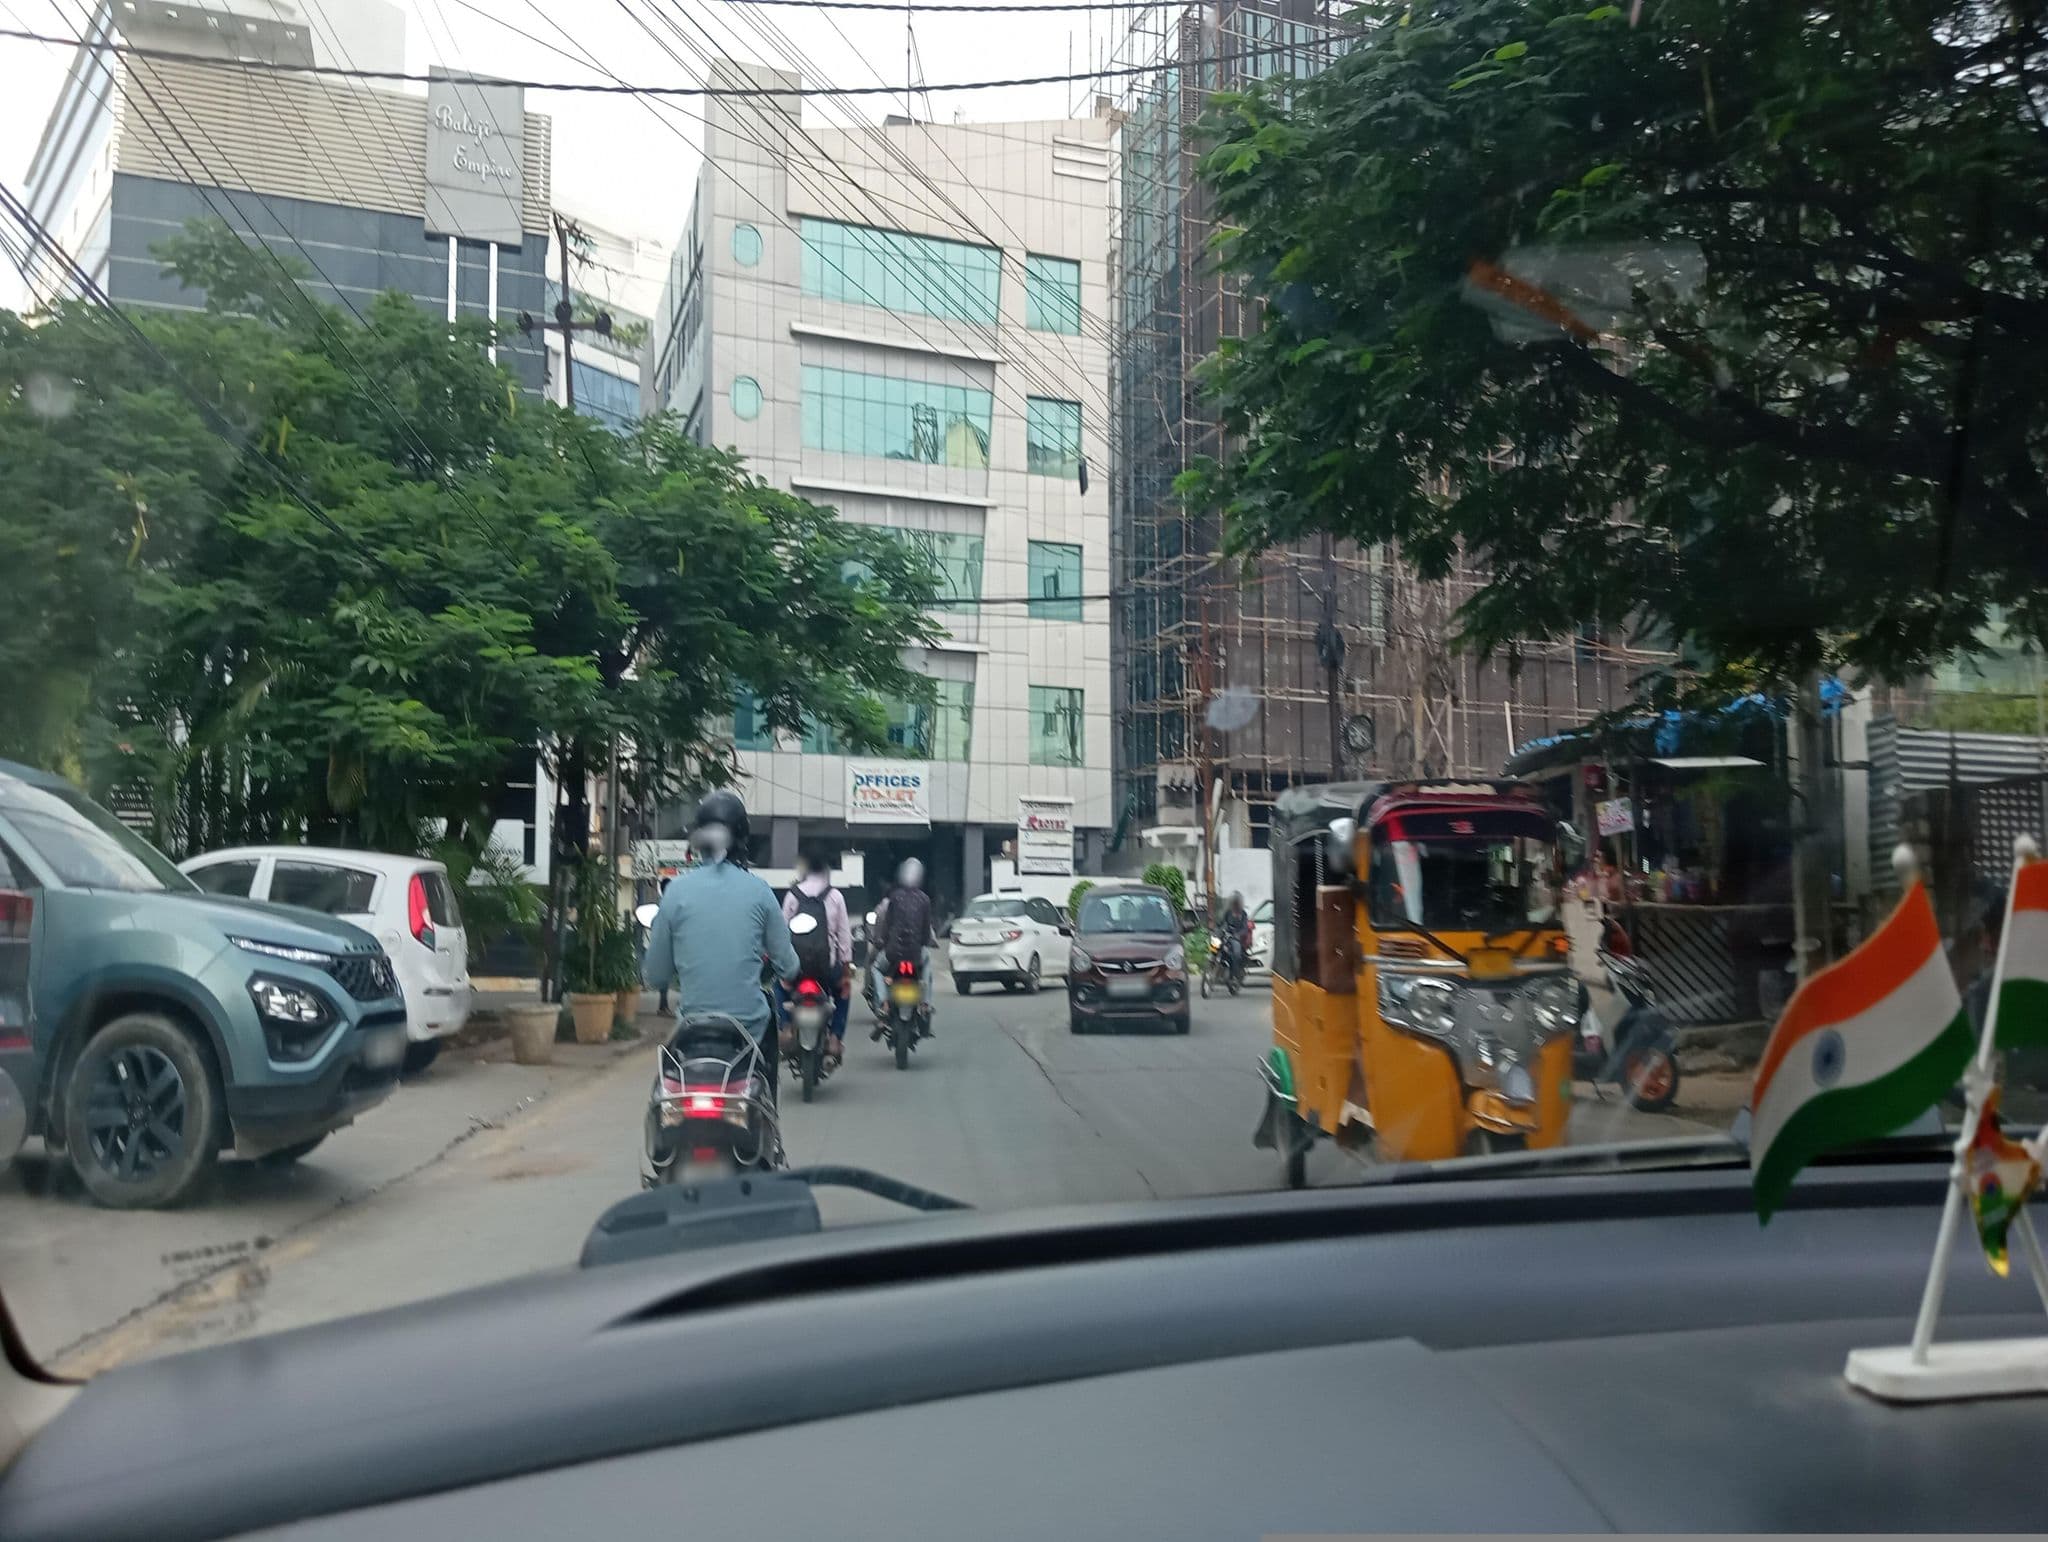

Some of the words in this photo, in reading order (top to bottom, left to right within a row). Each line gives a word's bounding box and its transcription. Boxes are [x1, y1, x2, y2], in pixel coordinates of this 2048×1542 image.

[435, 104, 491, 147] Balaji
[453, 145, 513, 183] Empire
[855, 774, 921, 787] OFFICES
